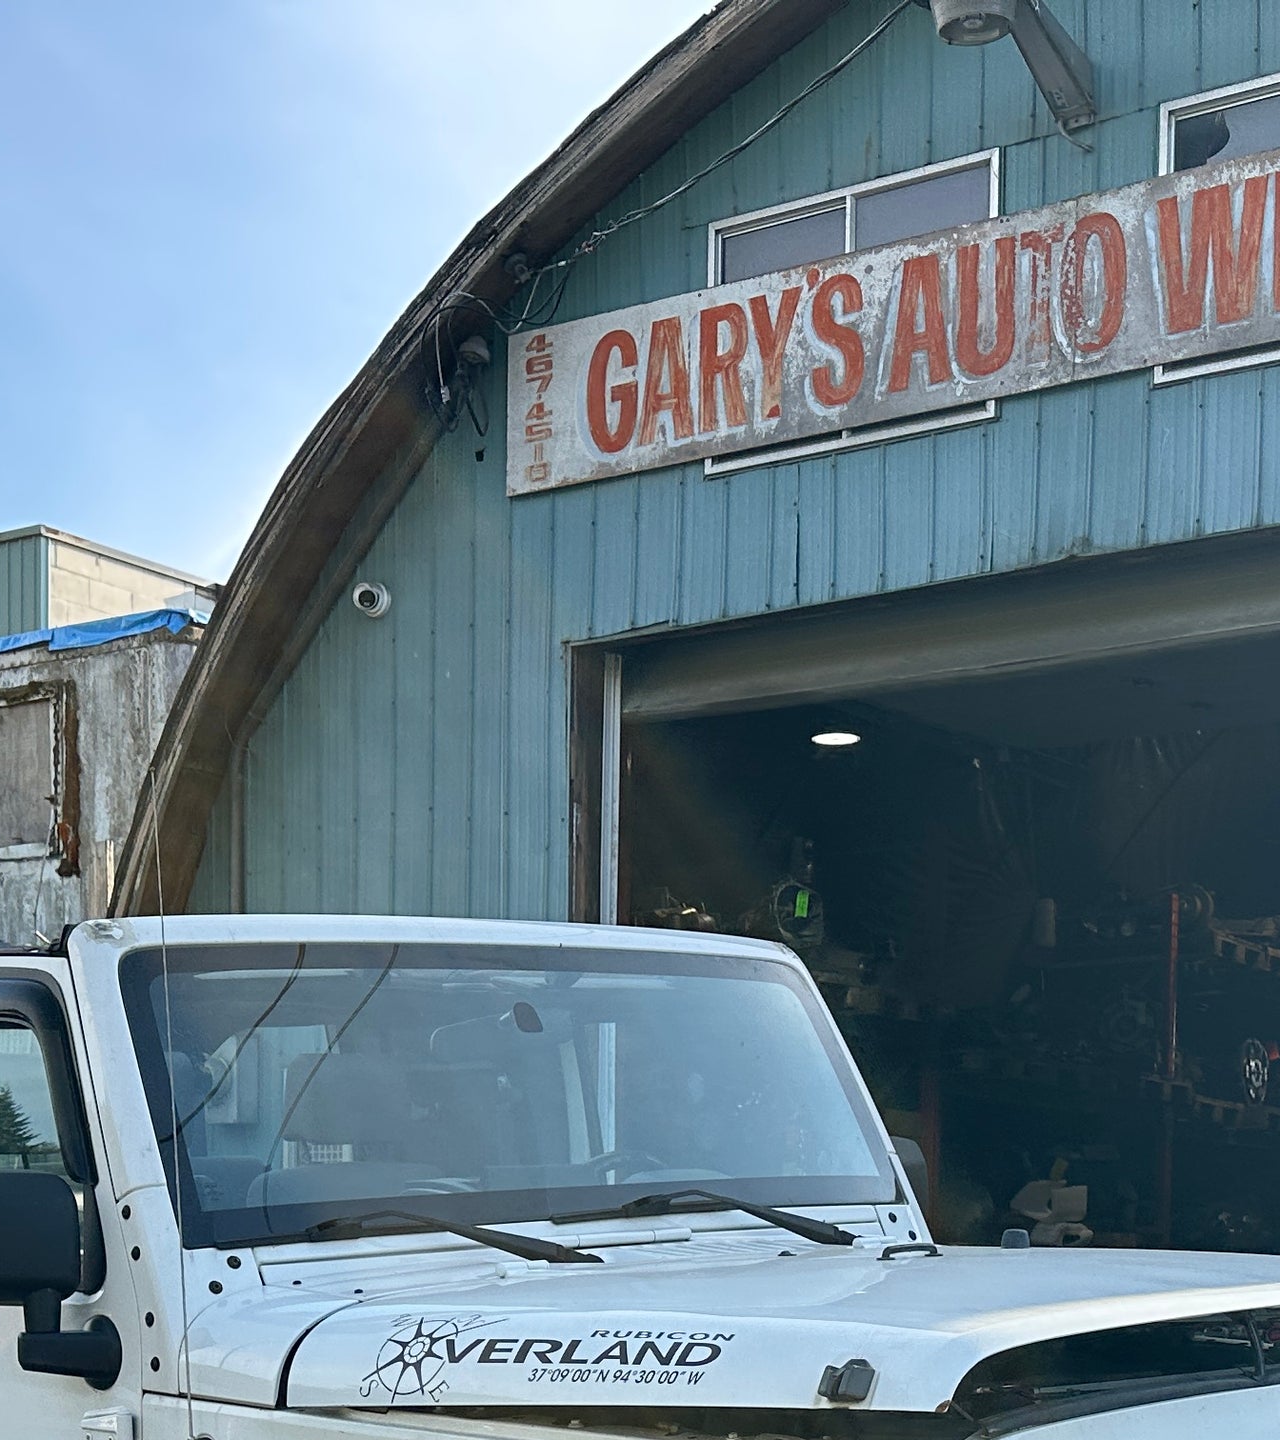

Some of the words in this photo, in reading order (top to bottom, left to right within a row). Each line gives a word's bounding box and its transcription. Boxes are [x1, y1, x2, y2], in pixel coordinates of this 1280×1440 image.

[586, 267, 866, 454] GARY'S
[888, 212, 1128, 394] AUTO
[590, 1329, 736, 1342] RUBICON
